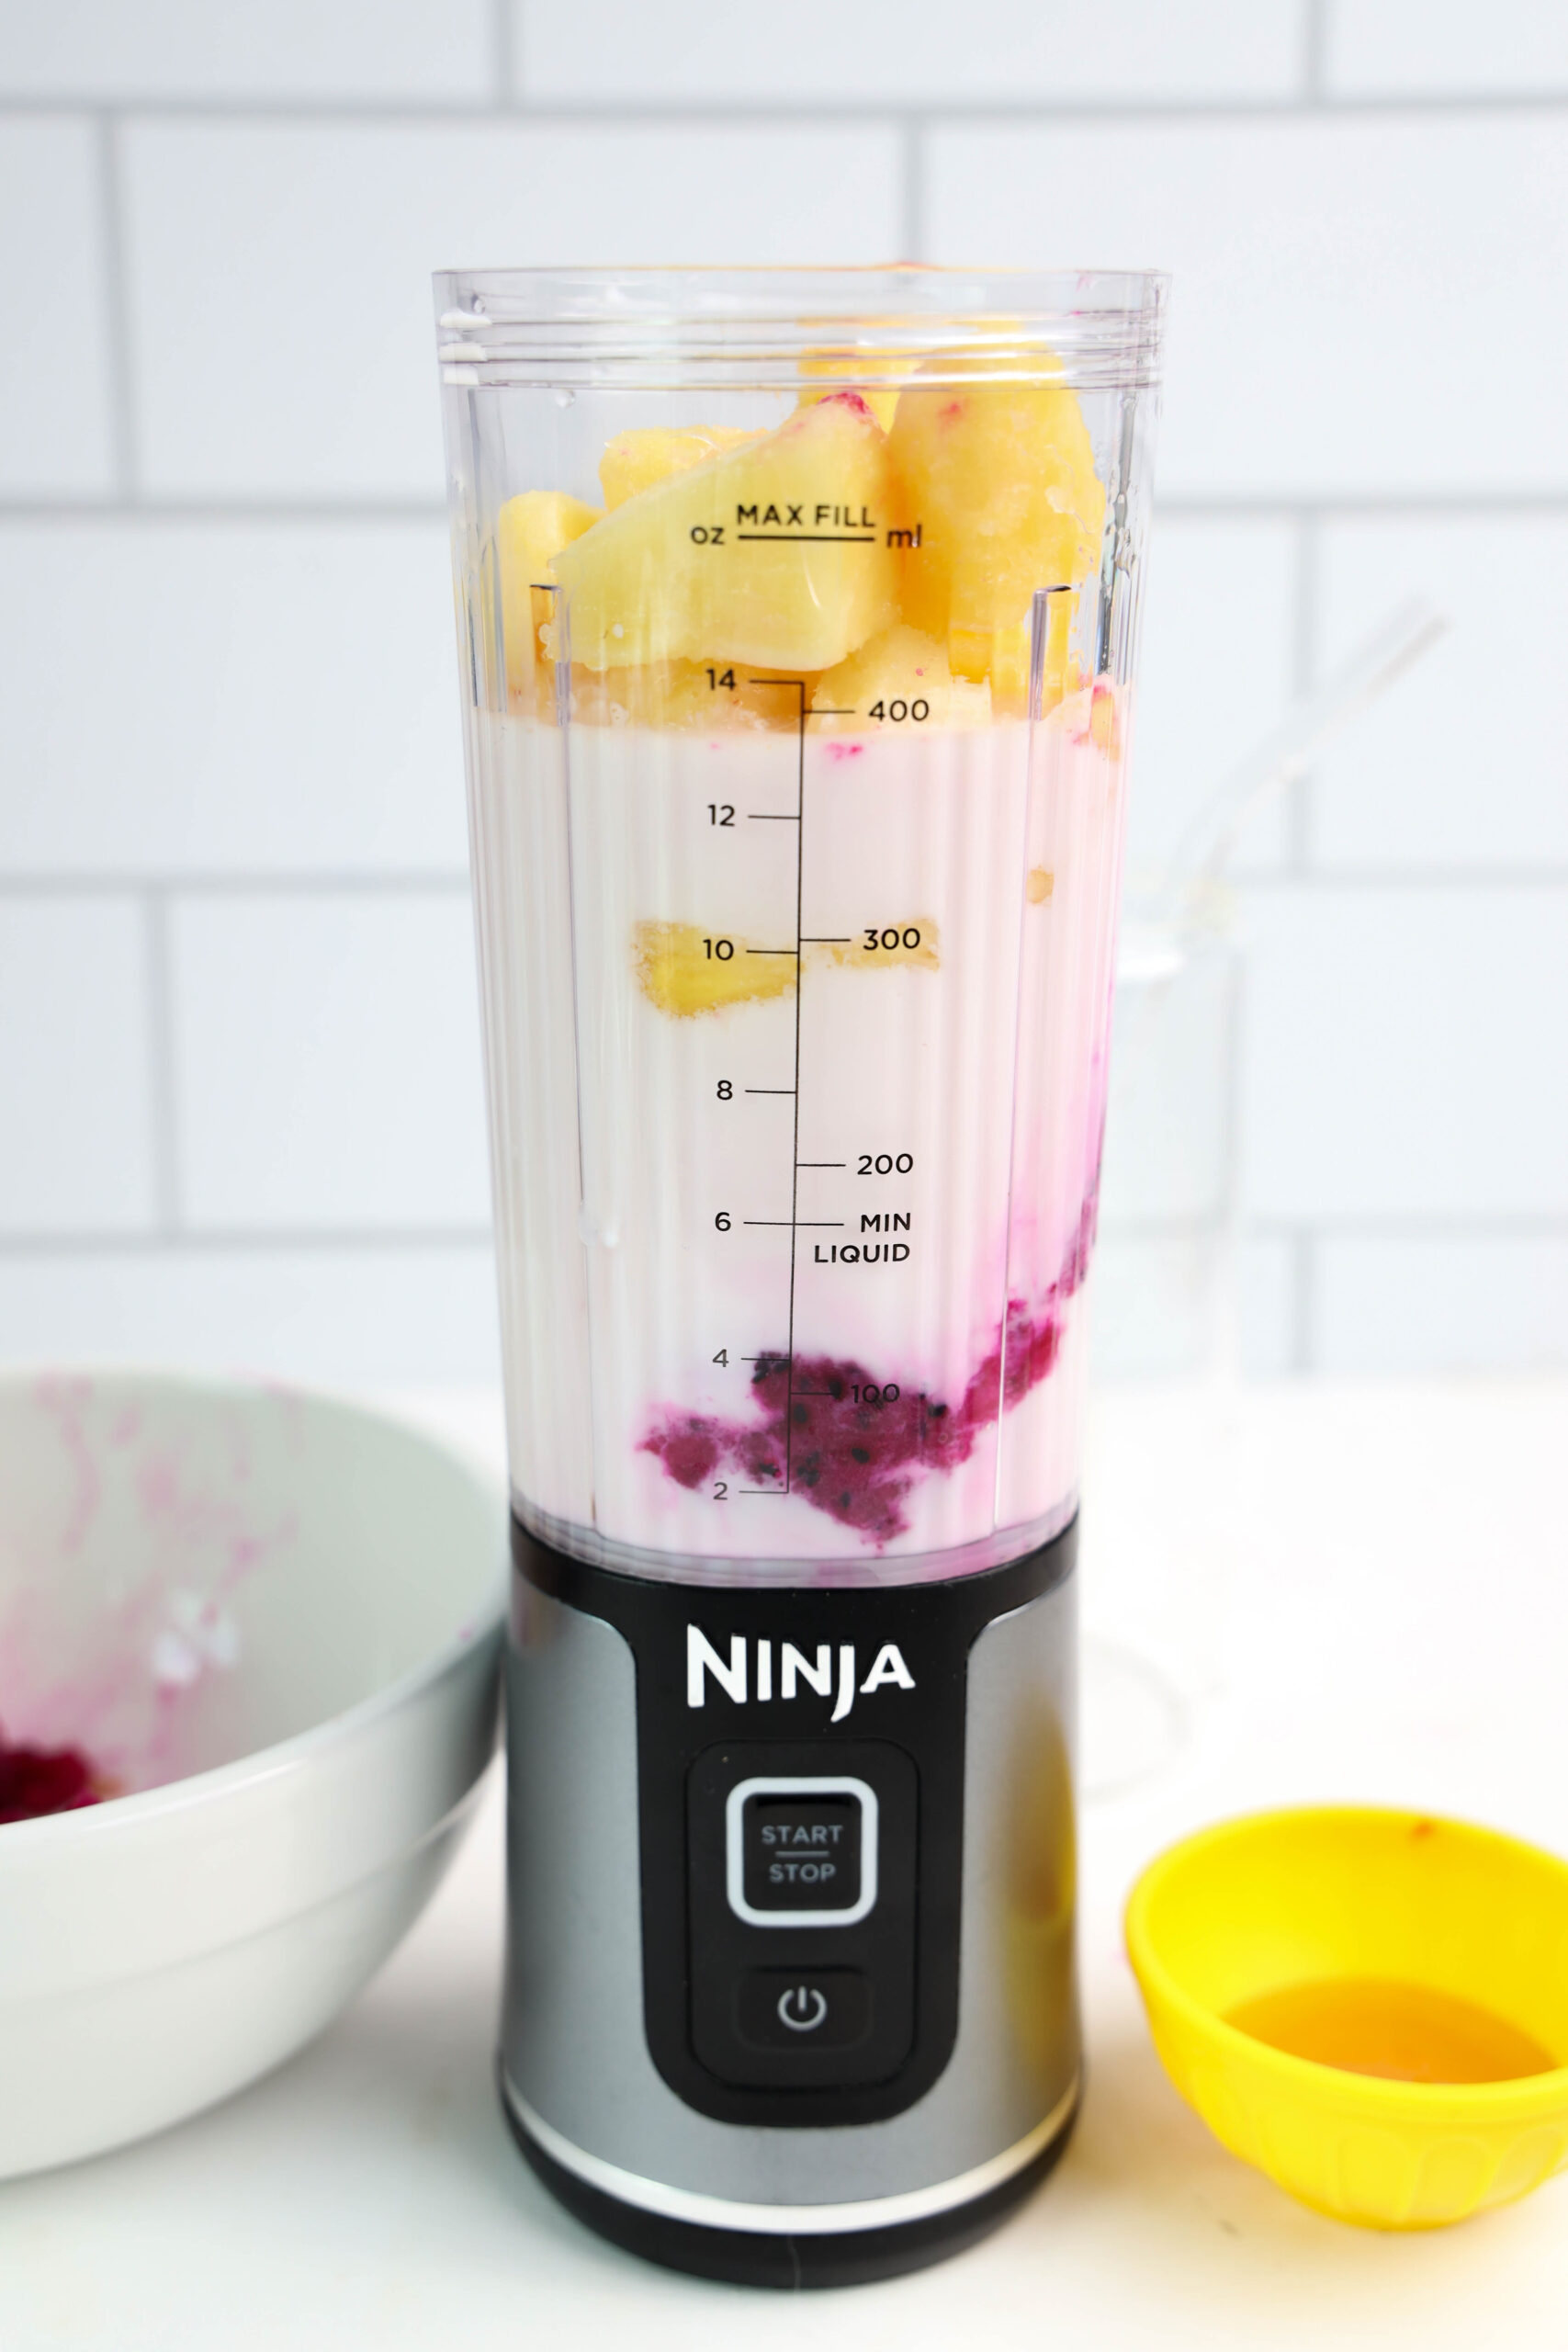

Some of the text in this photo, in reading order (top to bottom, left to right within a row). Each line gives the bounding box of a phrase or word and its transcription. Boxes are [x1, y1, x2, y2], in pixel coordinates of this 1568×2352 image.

[737, 504, 876, 527] MAX FILL
[691, 527, 726, 545] oz
[886, 525, 922, 548] ml
[705, 669, 737, 690] 14
[868, 699, 930, 721] 400
[706, 804, 736, 826] 12
[703, 939, 734, 960] 10
[863, 928, 920, 951] 300
[716, 1080, 733, 1100] 8
[857, 1153, 914, 1175] 200
[715, 1212, 731, 1231] 6
[861, 1213, 911, 1232] MIN
[814, 1243, 910, 1263] LIQUID
[712, 1349, 729, 1367] 4
[851, 1383, 900, 1404] 100
[713, 1482, 728, 1500] 2
[686, 1623, 915, 1723] NINJA
[761, 1825, 843, 1845] START
[769, 1863, 836, 1883] STOP
